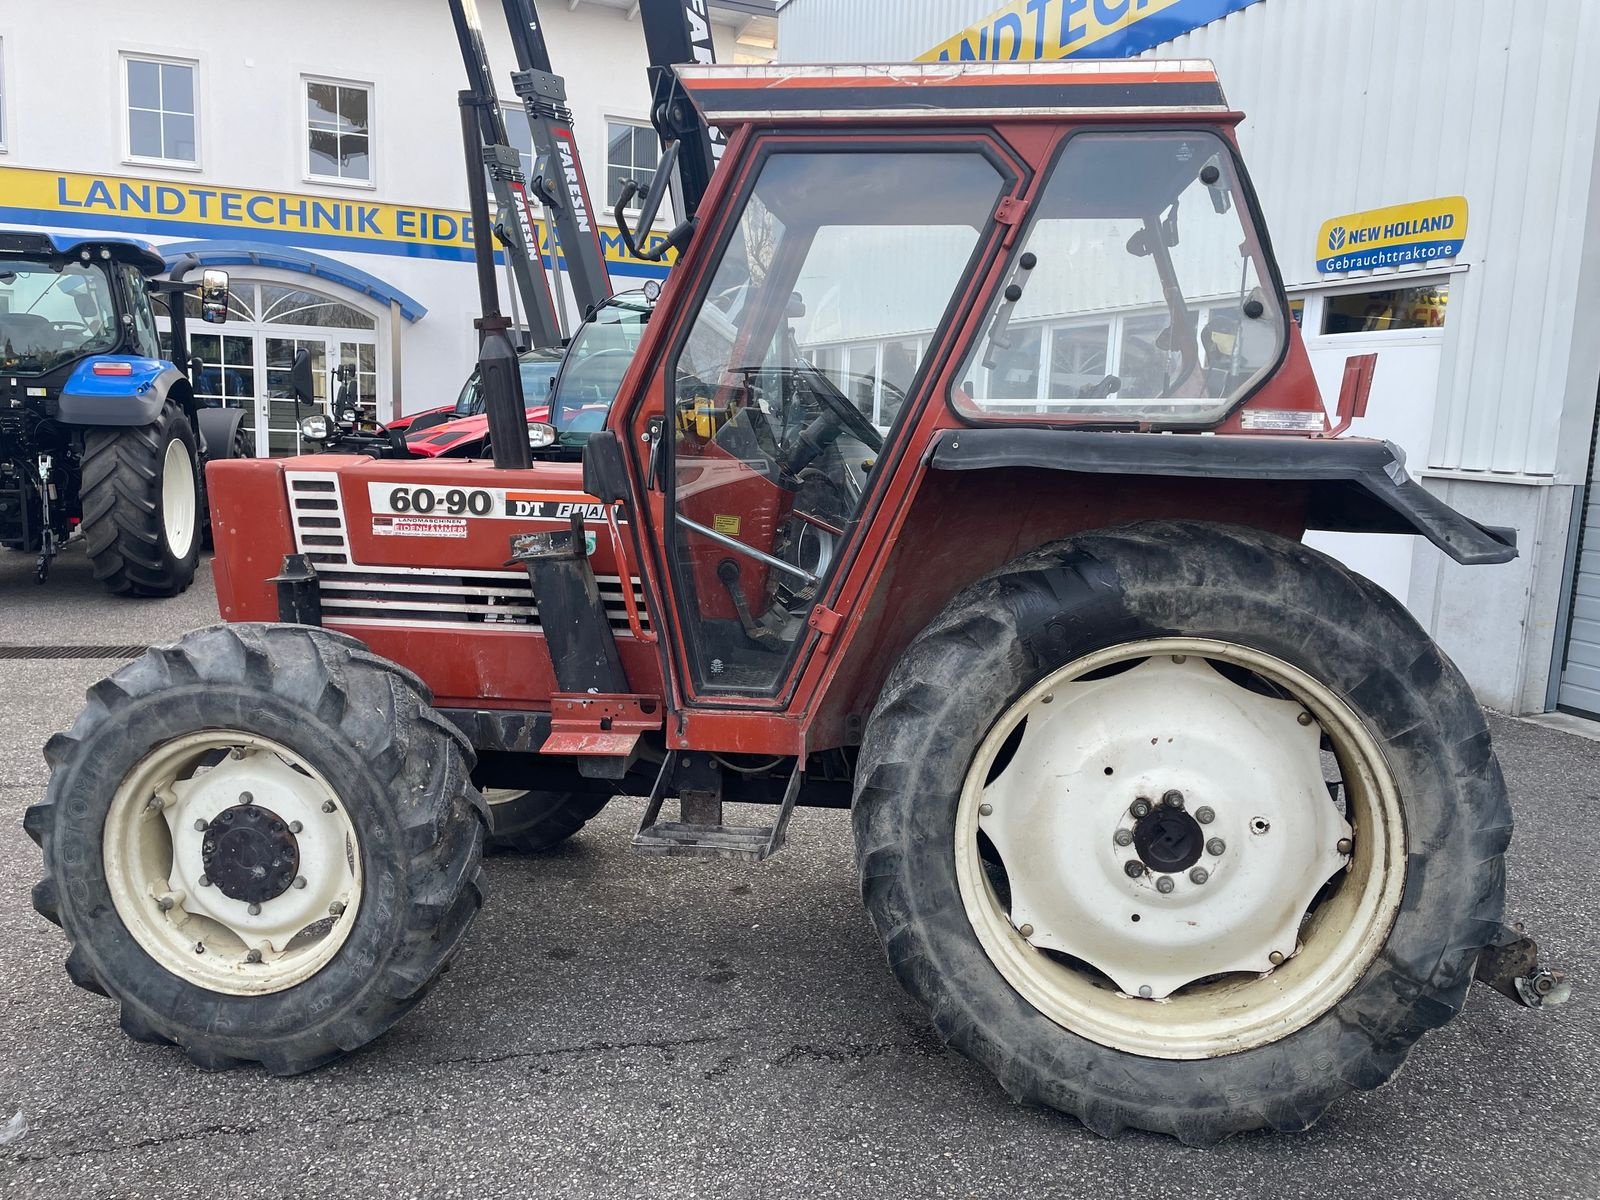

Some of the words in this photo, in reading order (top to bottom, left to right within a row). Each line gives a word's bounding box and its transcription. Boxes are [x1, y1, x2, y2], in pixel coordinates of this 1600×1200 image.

[556, 141, 591, 232] FARESIN
[57, 177, 384, 235] LANDTECHNIK
[396, 210, 669, 262] EIDEMR
[513, 192, 539, 260] FARESIN
[1348, 226, 1381, 244] NEW
[1383, 214, 1454, 239] HOLLAND
[1326, 245, 1453, 271] Gebrauchttraktore
[389, 487, 493, 516] 60-90
[515, 501, 545, 516] DT
[557, 503, 617, 519] FIA
[395, 524, 465, 533] EIDENHAMMER
